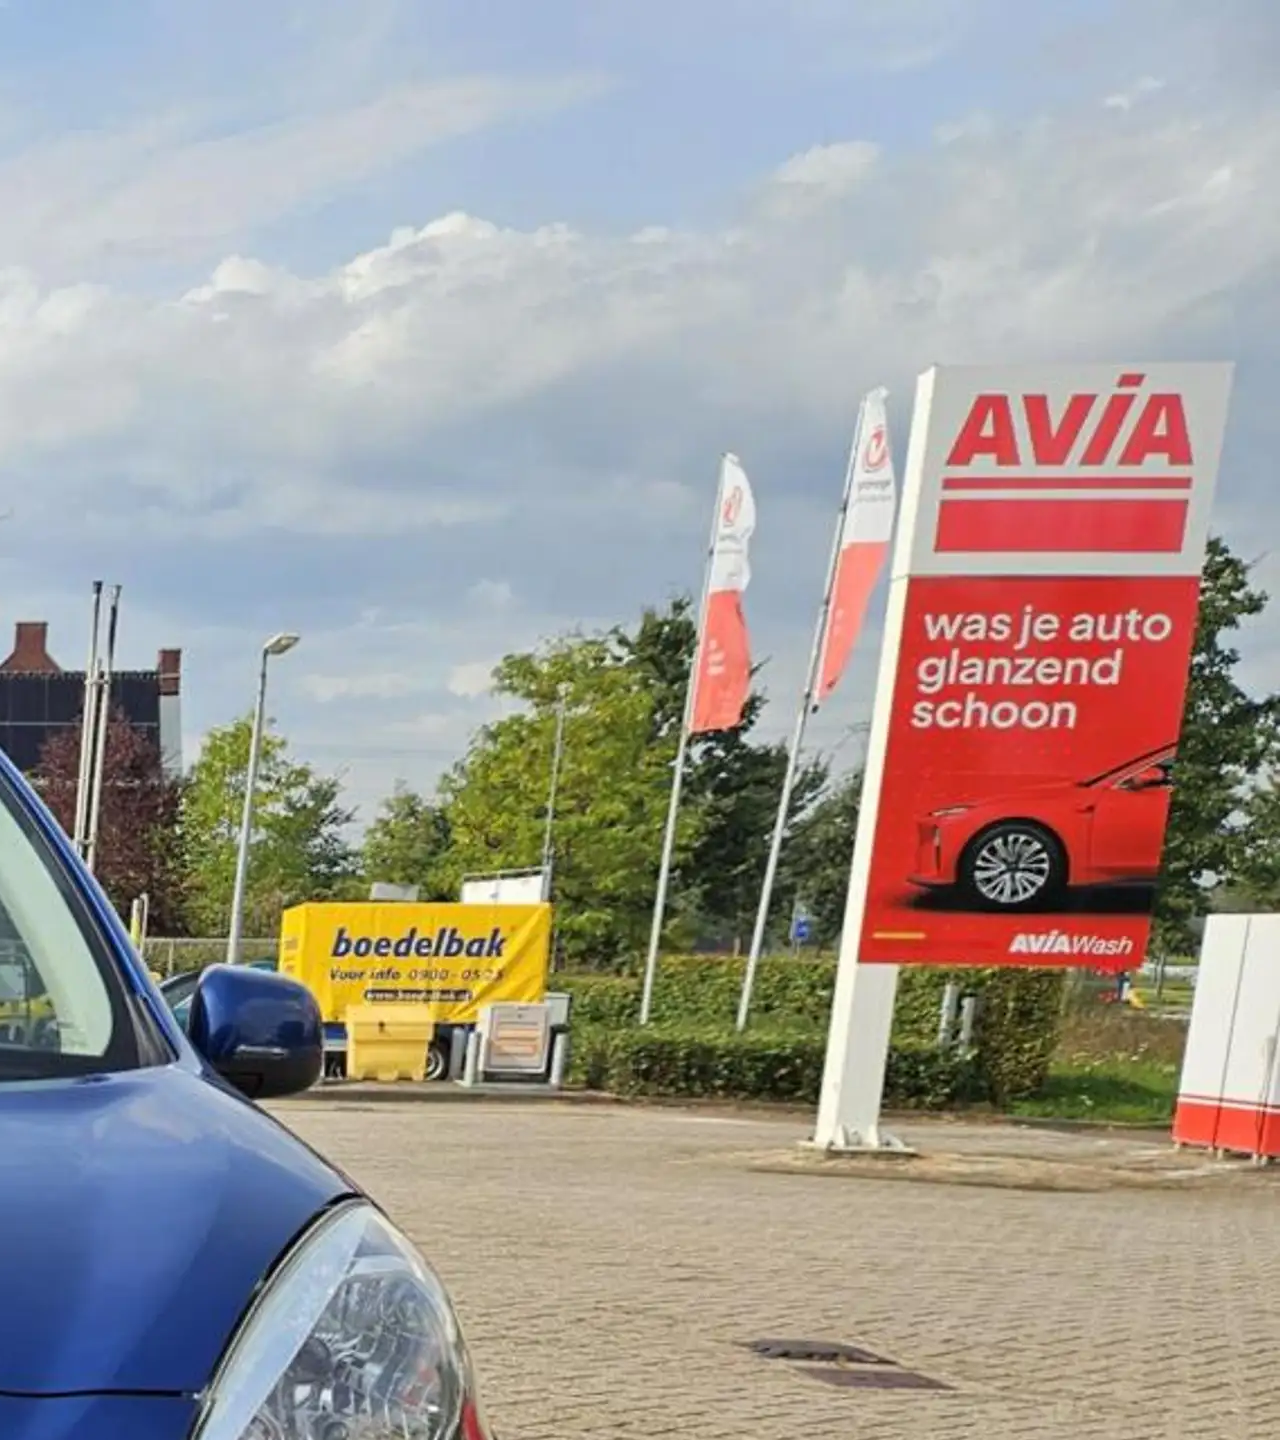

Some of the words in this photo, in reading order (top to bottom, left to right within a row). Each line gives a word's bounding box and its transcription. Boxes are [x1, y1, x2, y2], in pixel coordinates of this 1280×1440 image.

[924, 612, 1012, 641] was
[1014, 604, 1060, 650] je
[1068, 608, 1173, 641] auto
[917, 647, 1124, 694] glanzend
[911, 692, 1078, 729] schoon
[332, 926, 507, 958] boedelbak
[330, 967, 365, 981] Voor
[370, 967, 401, 981] info
